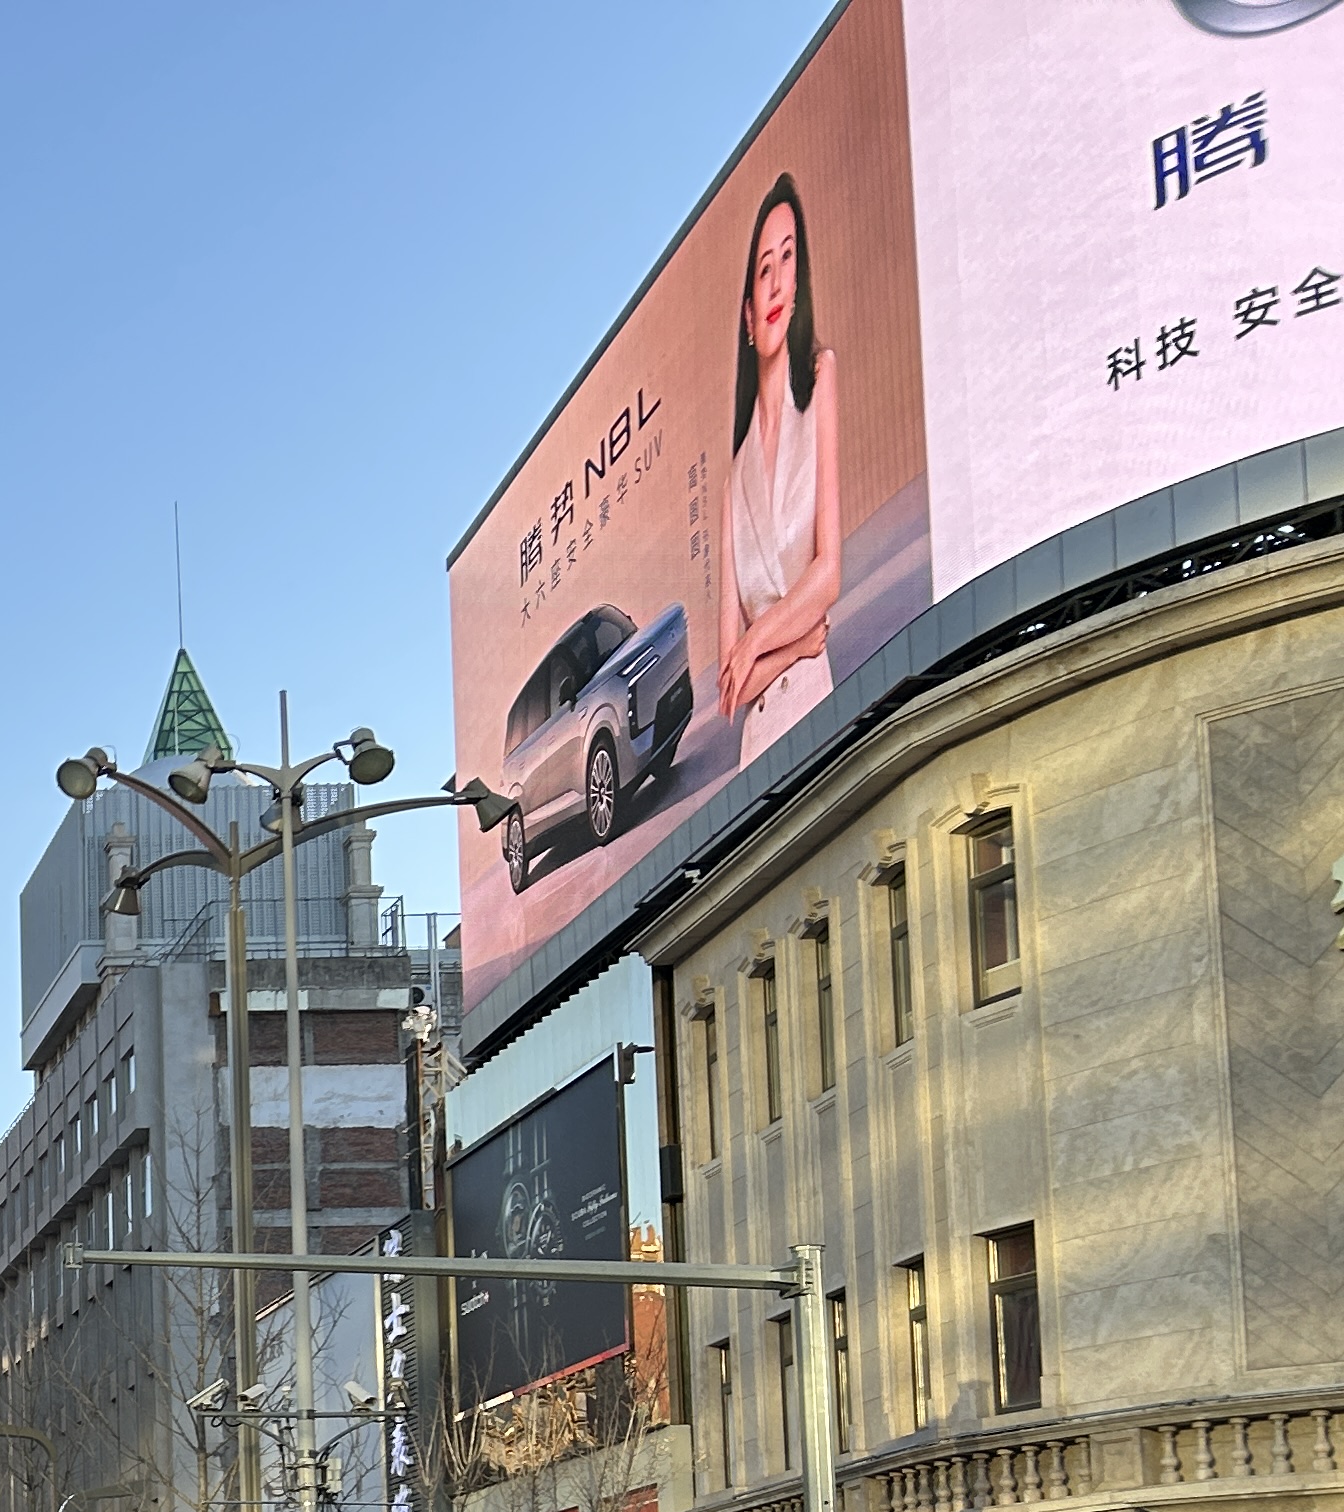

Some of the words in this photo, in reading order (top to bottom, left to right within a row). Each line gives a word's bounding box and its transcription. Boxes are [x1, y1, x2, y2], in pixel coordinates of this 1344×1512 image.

[1151, 89, 1268, 210] 腾
[1107, 316, 1200, 391] 科技
[1233, 265, 1344, 341] 安全
[519, 479, 574, 588] 腾势
